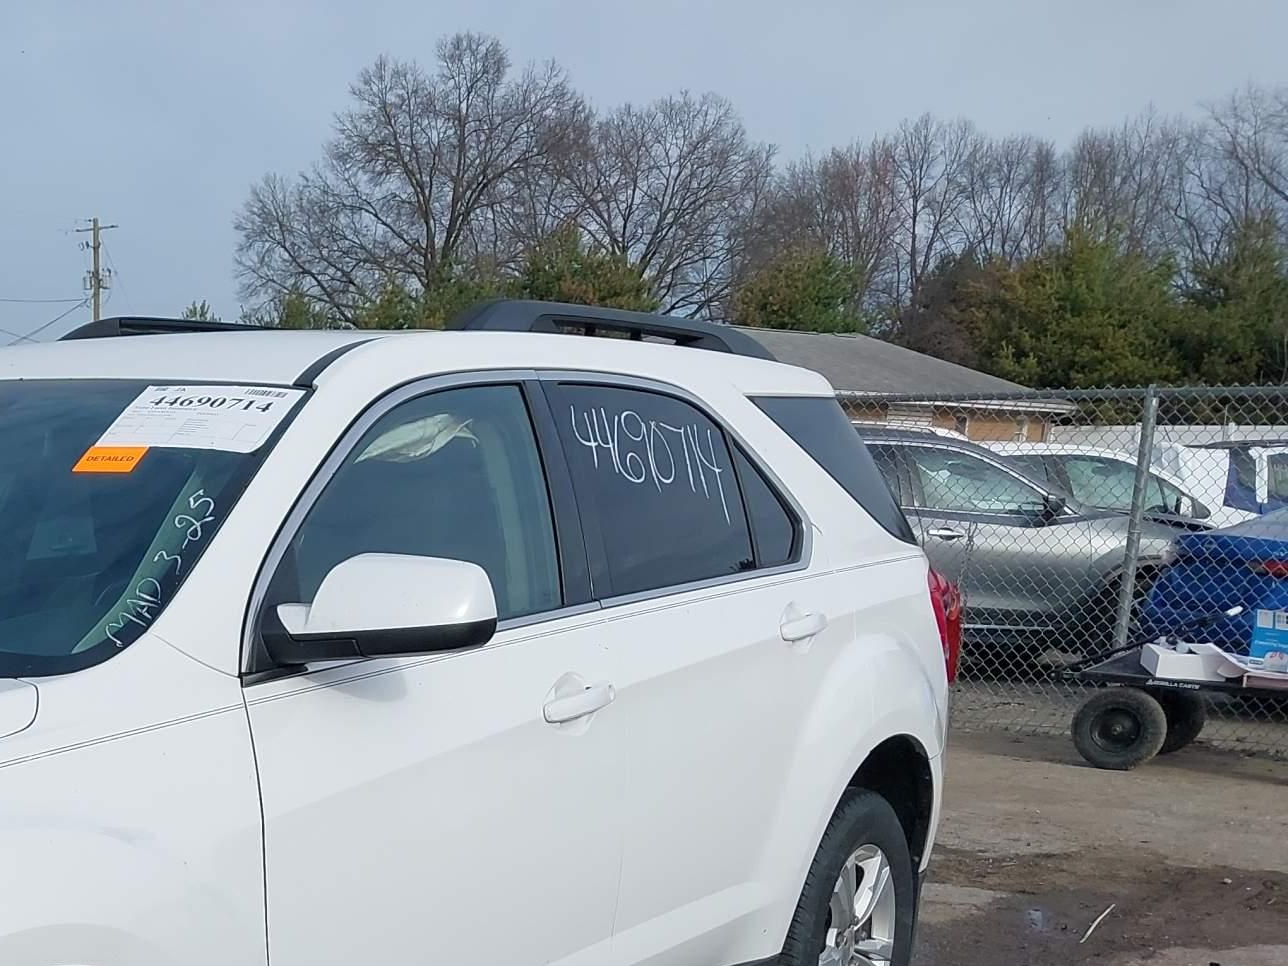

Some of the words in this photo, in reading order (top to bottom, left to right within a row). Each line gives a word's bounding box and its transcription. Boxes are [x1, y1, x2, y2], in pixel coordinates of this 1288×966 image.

[150, 394, 274, 413] 44690714
[570, 405, 731, 526] 44690714
[105, 577, 163, 648] MAD
